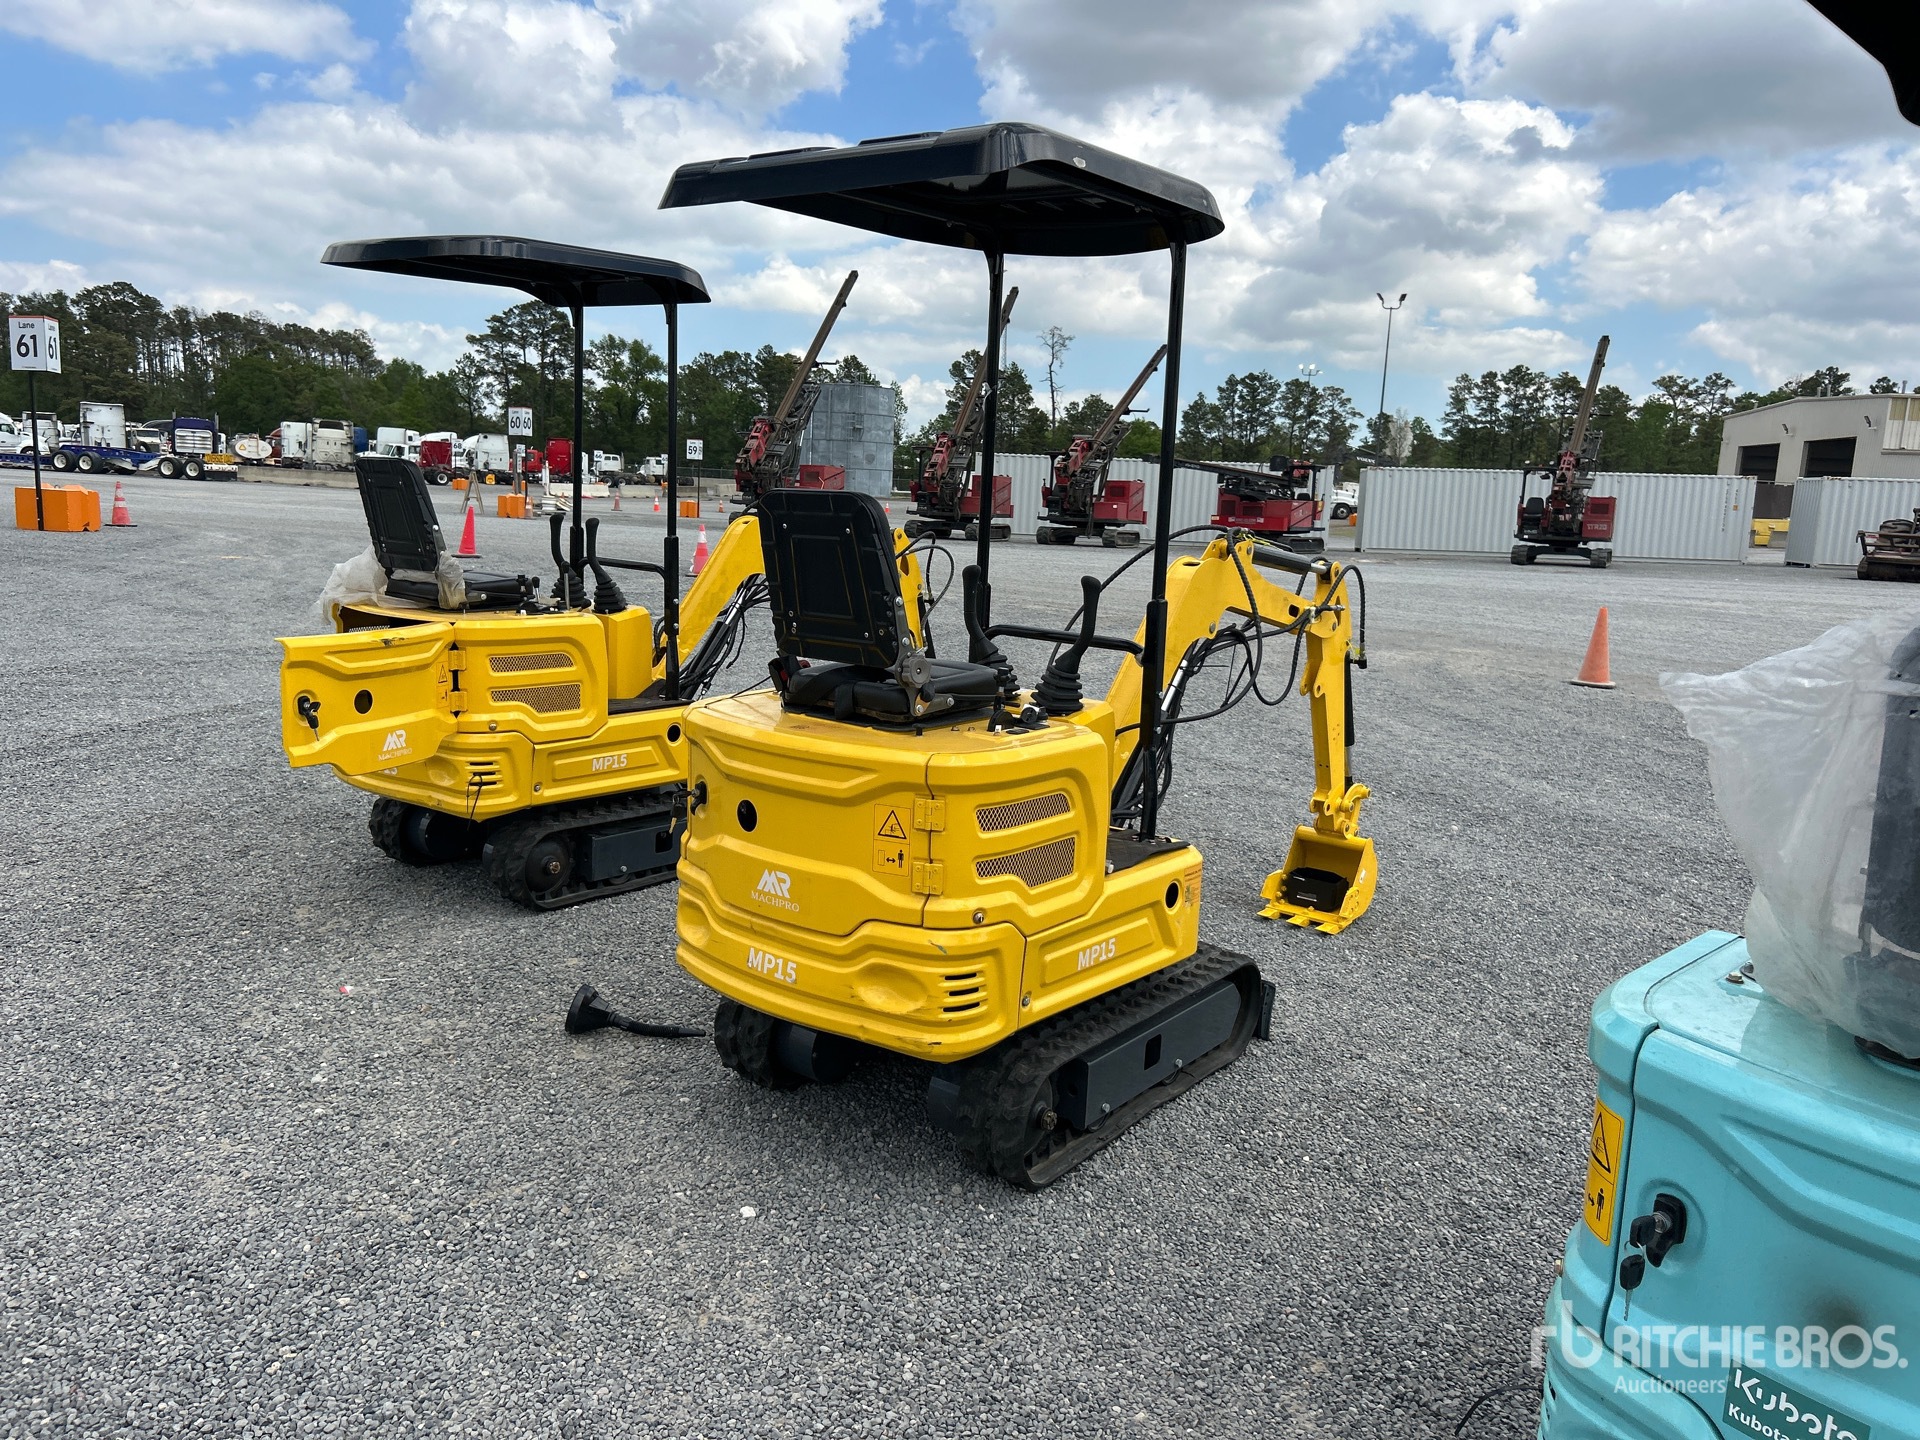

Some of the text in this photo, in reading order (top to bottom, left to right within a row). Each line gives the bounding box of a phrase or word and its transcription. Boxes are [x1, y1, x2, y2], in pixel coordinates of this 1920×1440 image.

[18, 321, 35, 329] Lane
[16, 333, 38, 358] 61
[48, 335, 58, 360] 61
[510, 416, 521, 429] 60
[523, 417, 532, 430] 60
[453, 442, 463, 450] 68
[688, 445, 698, 455] 59
[592, 753, 628, 772] MP15
[751, 890, 800, 913] MACHPRO
[1077, 937, 1116, 971] MP15
[747, 947, 797, 984] MP15
